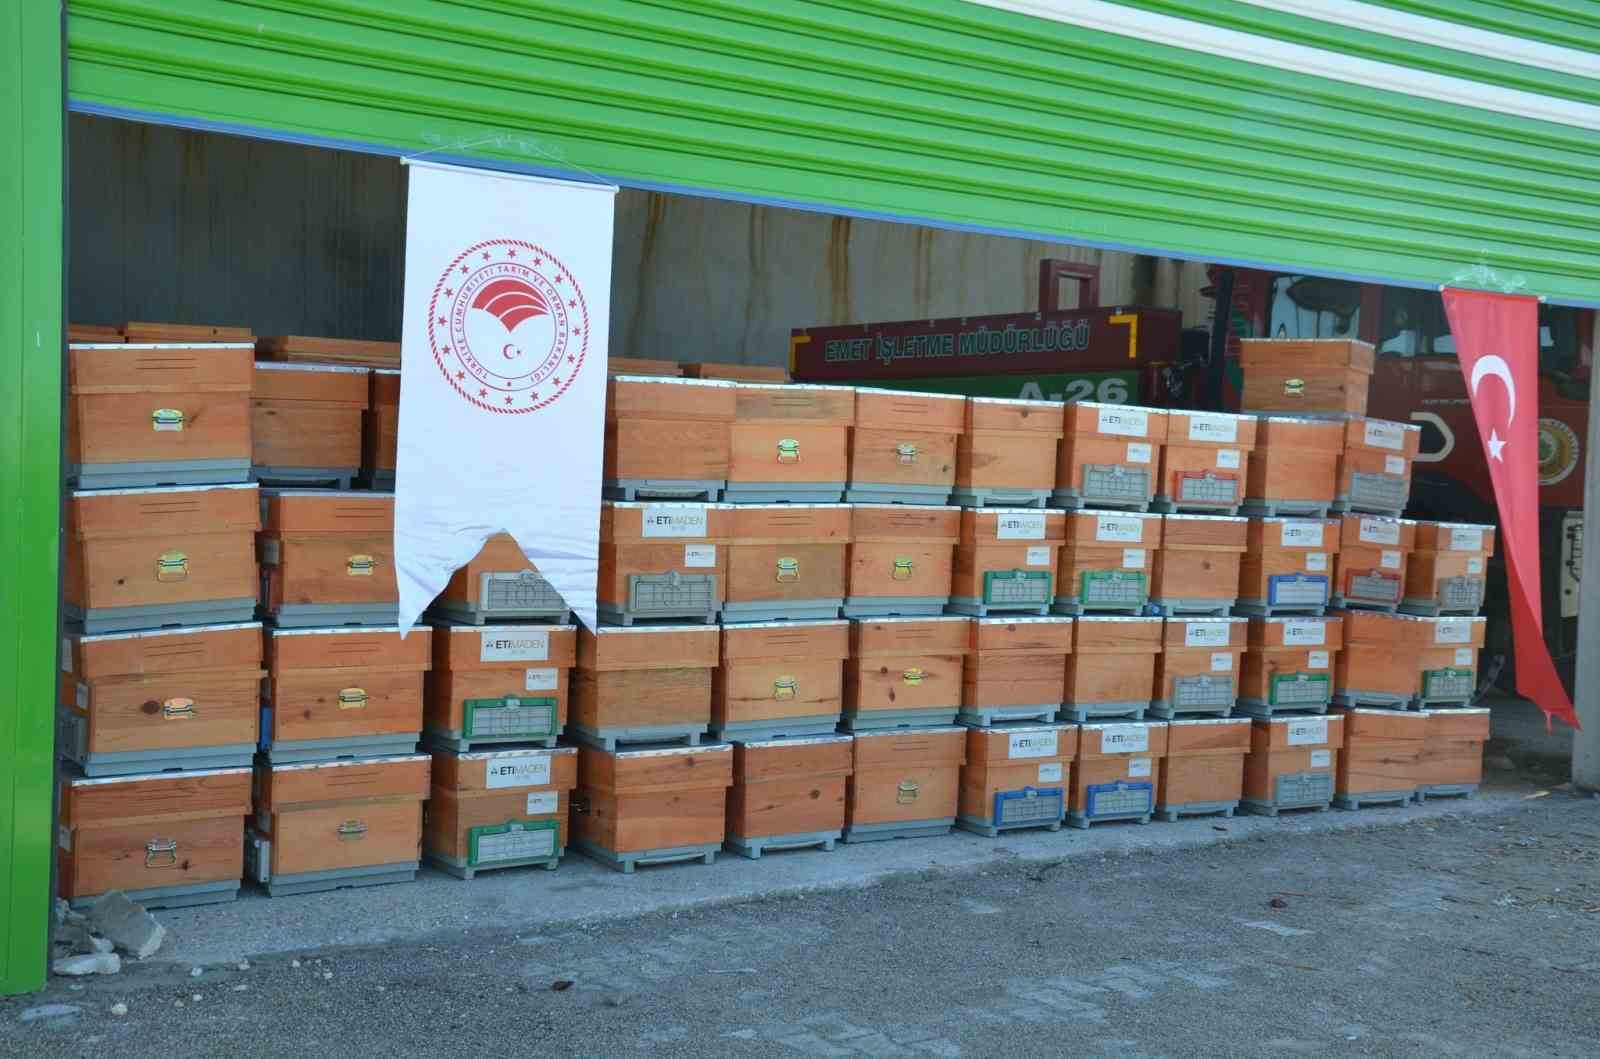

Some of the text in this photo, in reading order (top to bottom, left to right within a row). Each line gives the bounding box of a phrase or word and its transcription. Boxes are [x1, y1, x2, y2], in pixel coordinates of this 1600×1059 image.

[498, 266, 530, 278] TARIM
[534, 275, 546, 287] VE
[545, 288, 566, 327] ORMAN
[824, 318, 1090, 366] EMET İŞLETME MÜDÜRLÜĞÜ
